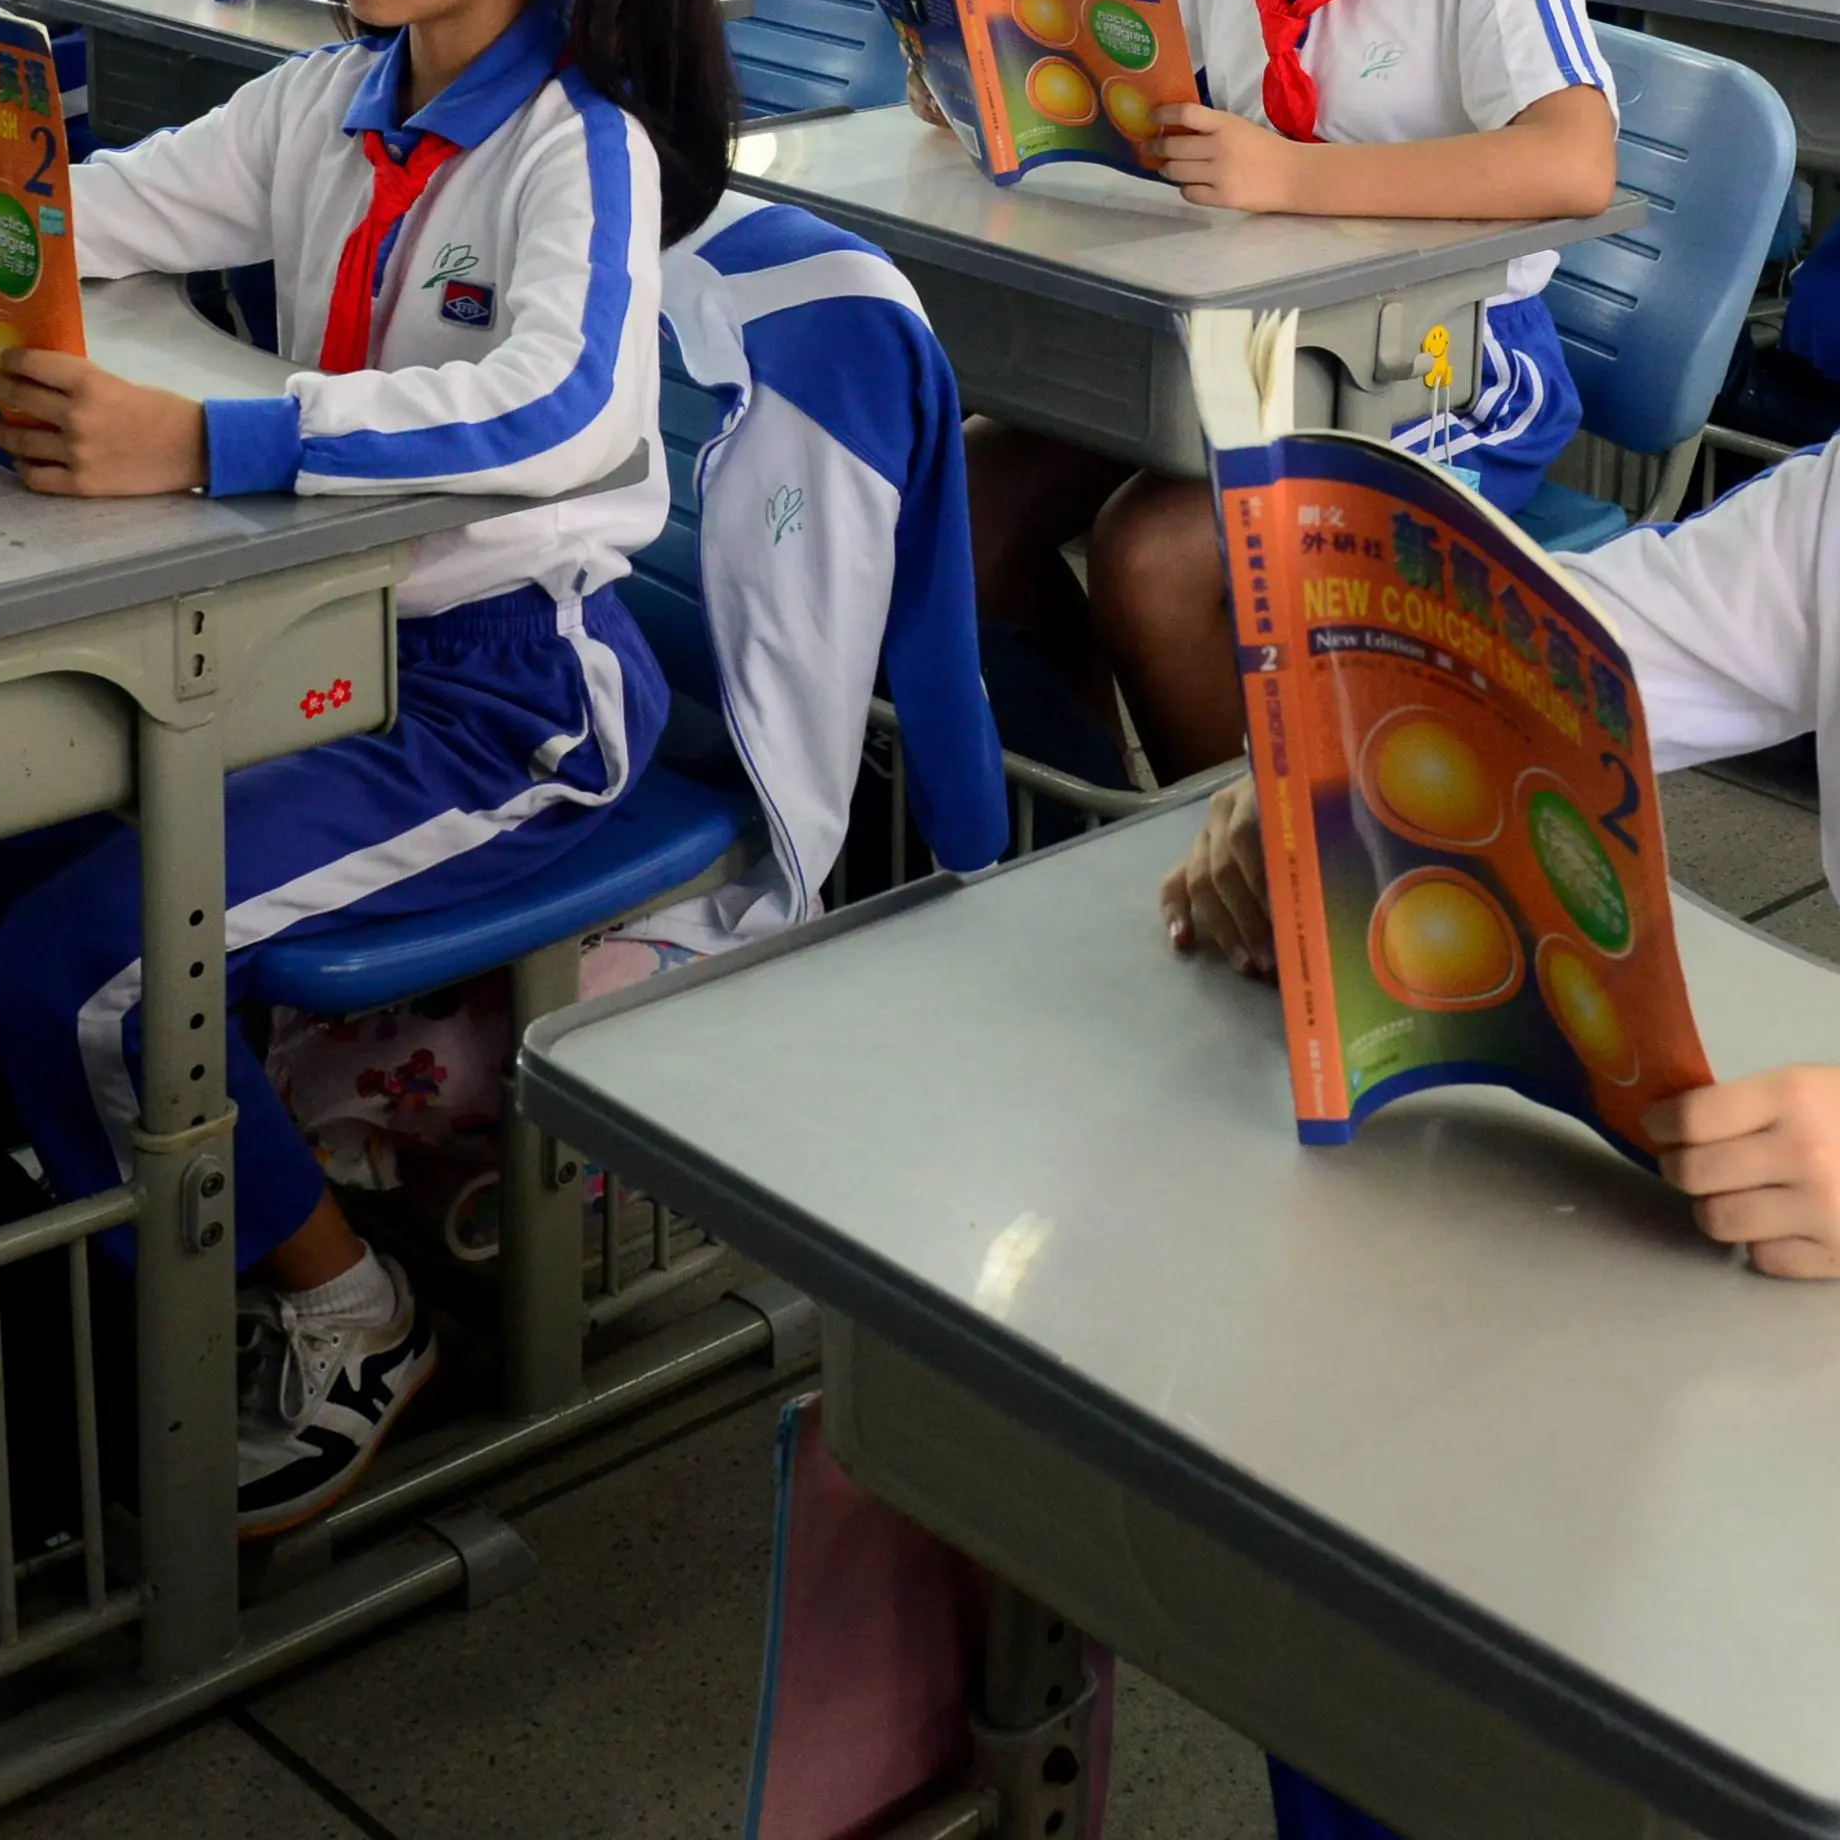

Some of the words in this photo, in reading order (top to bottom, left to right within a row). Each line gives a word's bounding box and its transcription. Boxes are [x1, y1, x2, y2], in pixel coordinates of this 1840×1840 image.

[25, 126, 56, 196] 2
[1302, 532, 1382, 558] 外研社
[1260, 647, 1278, 671] 2
[1304, 578, 1371, 621] NEW
[1382, 586, 1493, 667] CONCEPT
[1500, 650, 1583, 746] ENGLISH
[1316, 631, 1358, 649] New
[1364, 631, 1426, 659] Edition
[1599, 752, 1641, 856] 2
